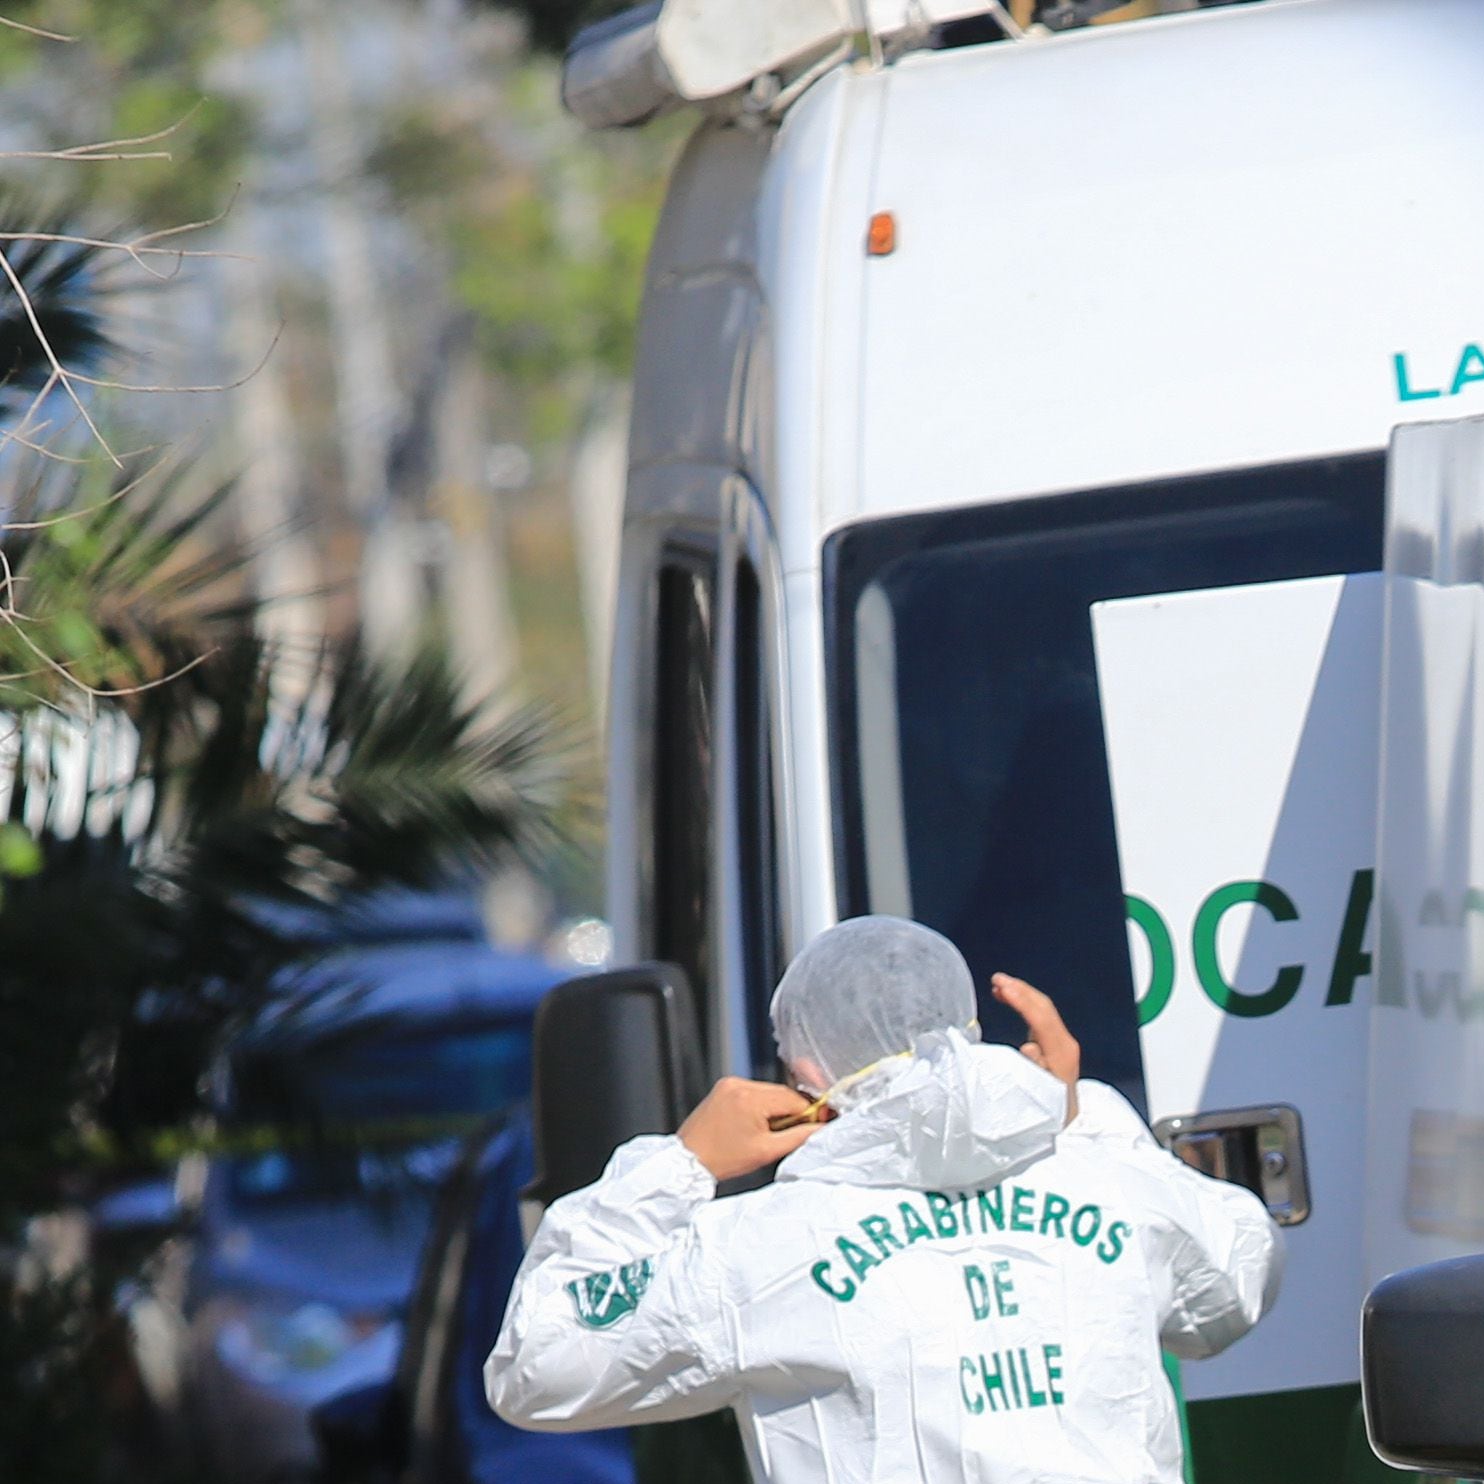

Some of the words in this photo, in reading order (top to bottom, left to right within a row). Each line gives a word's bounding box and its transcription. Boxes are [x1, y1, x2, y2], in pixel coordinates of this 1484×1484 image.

[811, 1185, 1132, 1304] CARABINEROS
[961, 1260, 1019, 1320] DE
[959, 1343, 1064, 1415] CHILE
